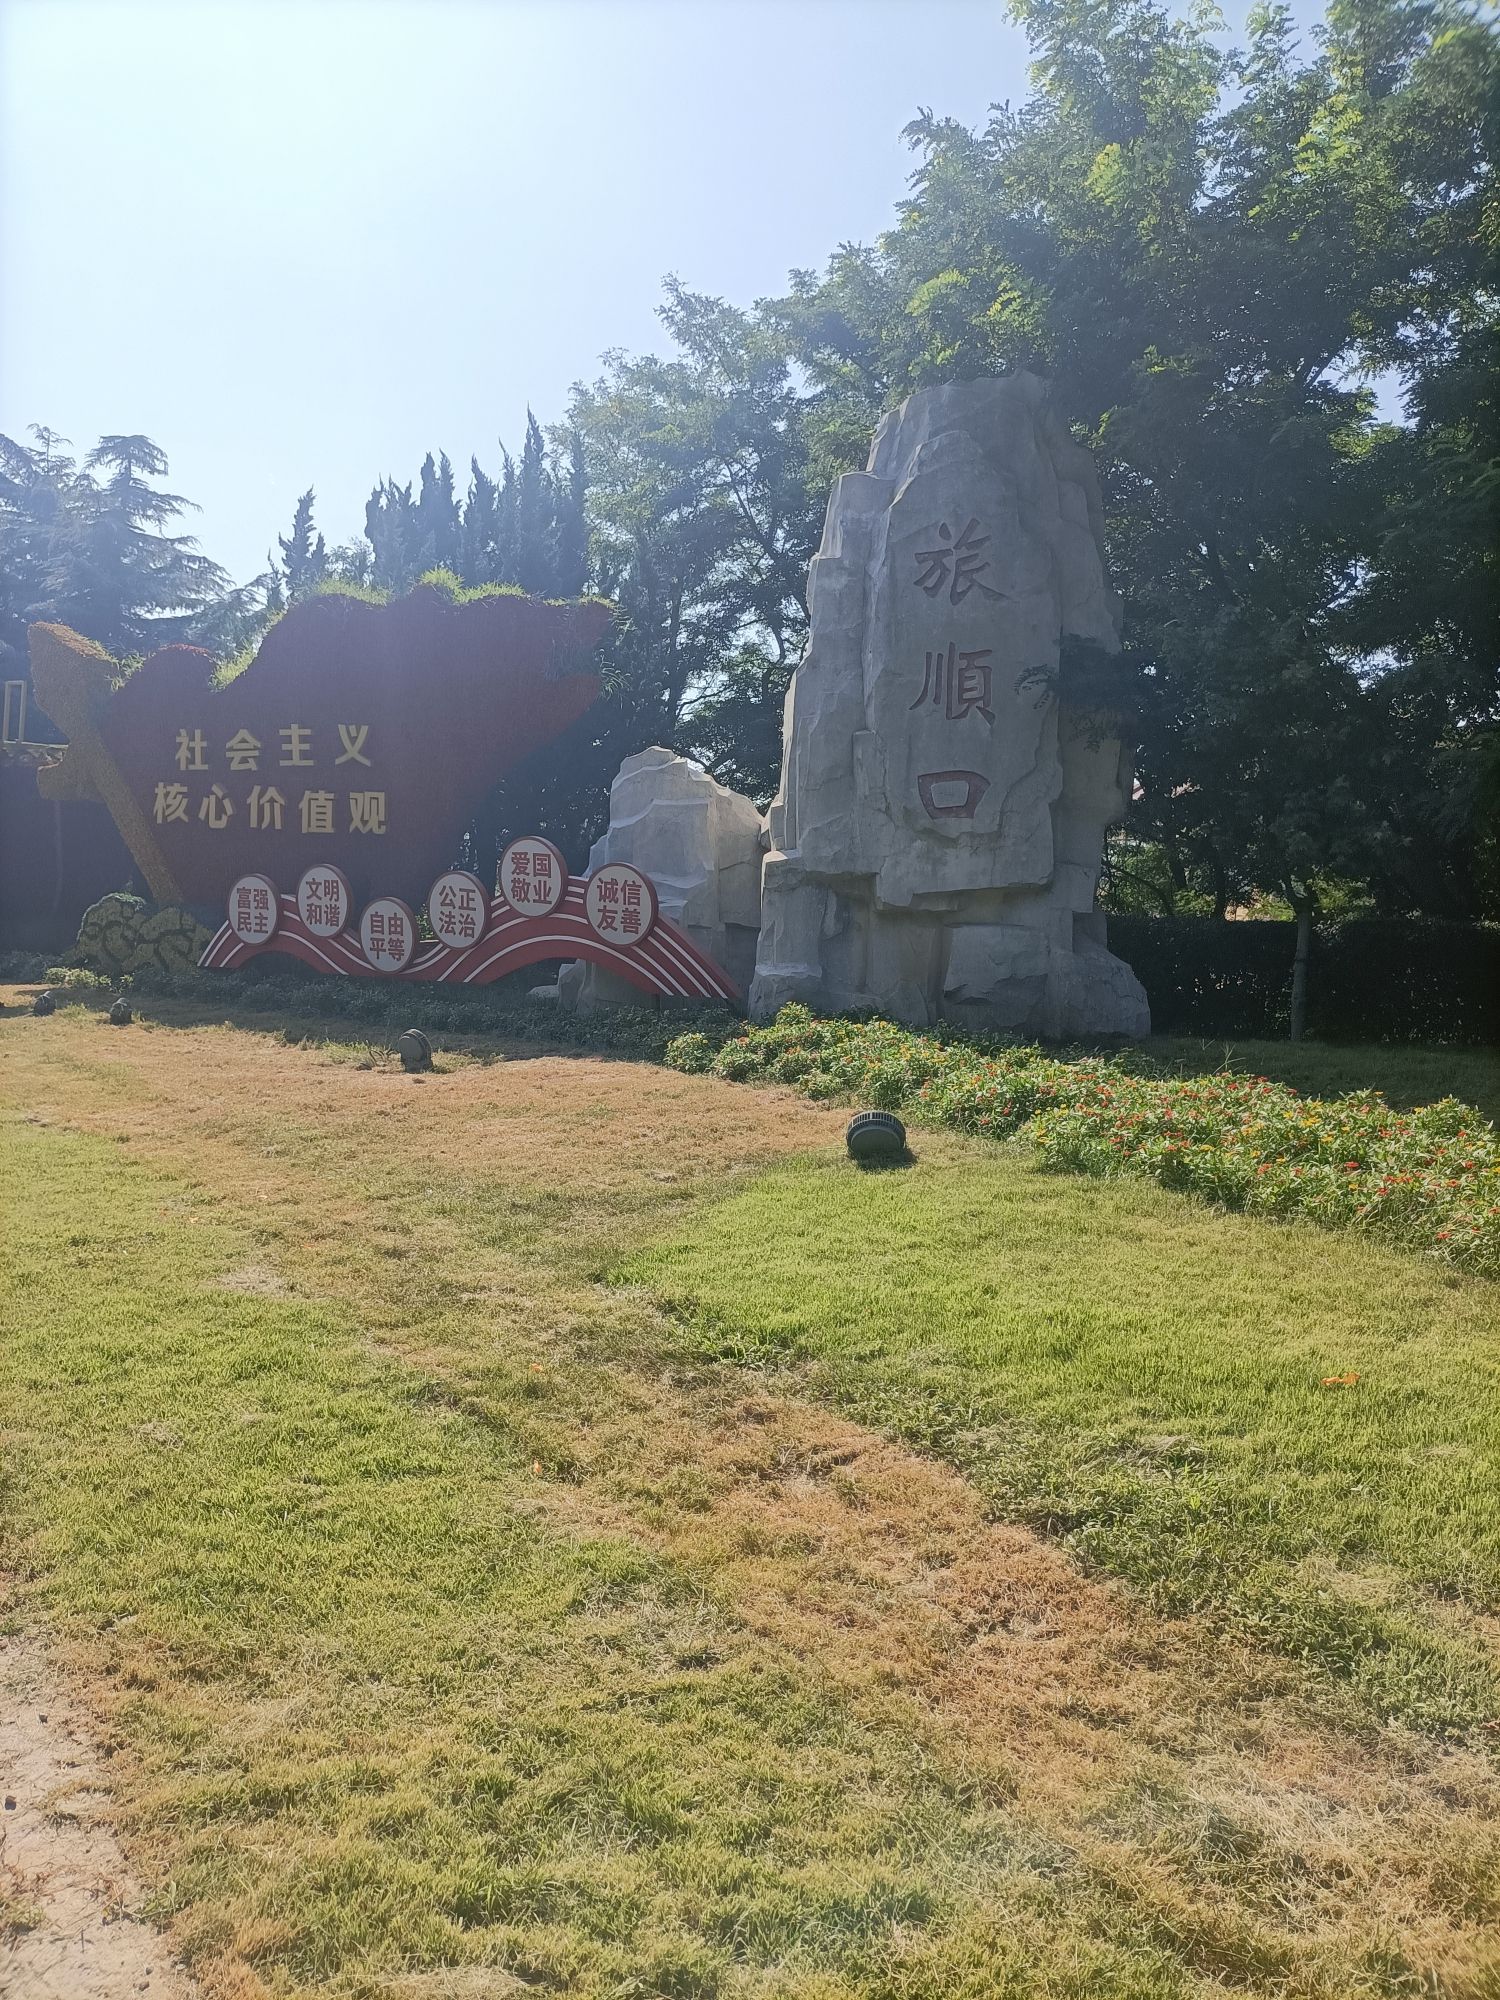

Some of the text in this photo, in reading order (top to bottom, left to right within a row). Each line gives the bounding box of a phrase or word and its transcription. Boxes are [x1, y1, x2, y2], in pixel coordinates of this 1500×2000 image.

[175, 723, 371, 771] 社会主义
[153, 782, 387, 834] 核心价值观
[511, 851, 552, 878] 爱国
[236, 887, 269, 911] 富强
[306, 878, 340, 902] 文明
[439, 885, 476, 911] 公正
[511, 878, 552, 904] 敬业
[597, 878, 642, 906] 诚信
[237, 911, 269, 934] 民主
[306, 903, 340, 927] 和谐
[370, 911, 404, 936] 自由
[439, 911, 476, 938] 法治
[597, 905, 641, 934] 友善
[370, 937, 404, 961] 平等
